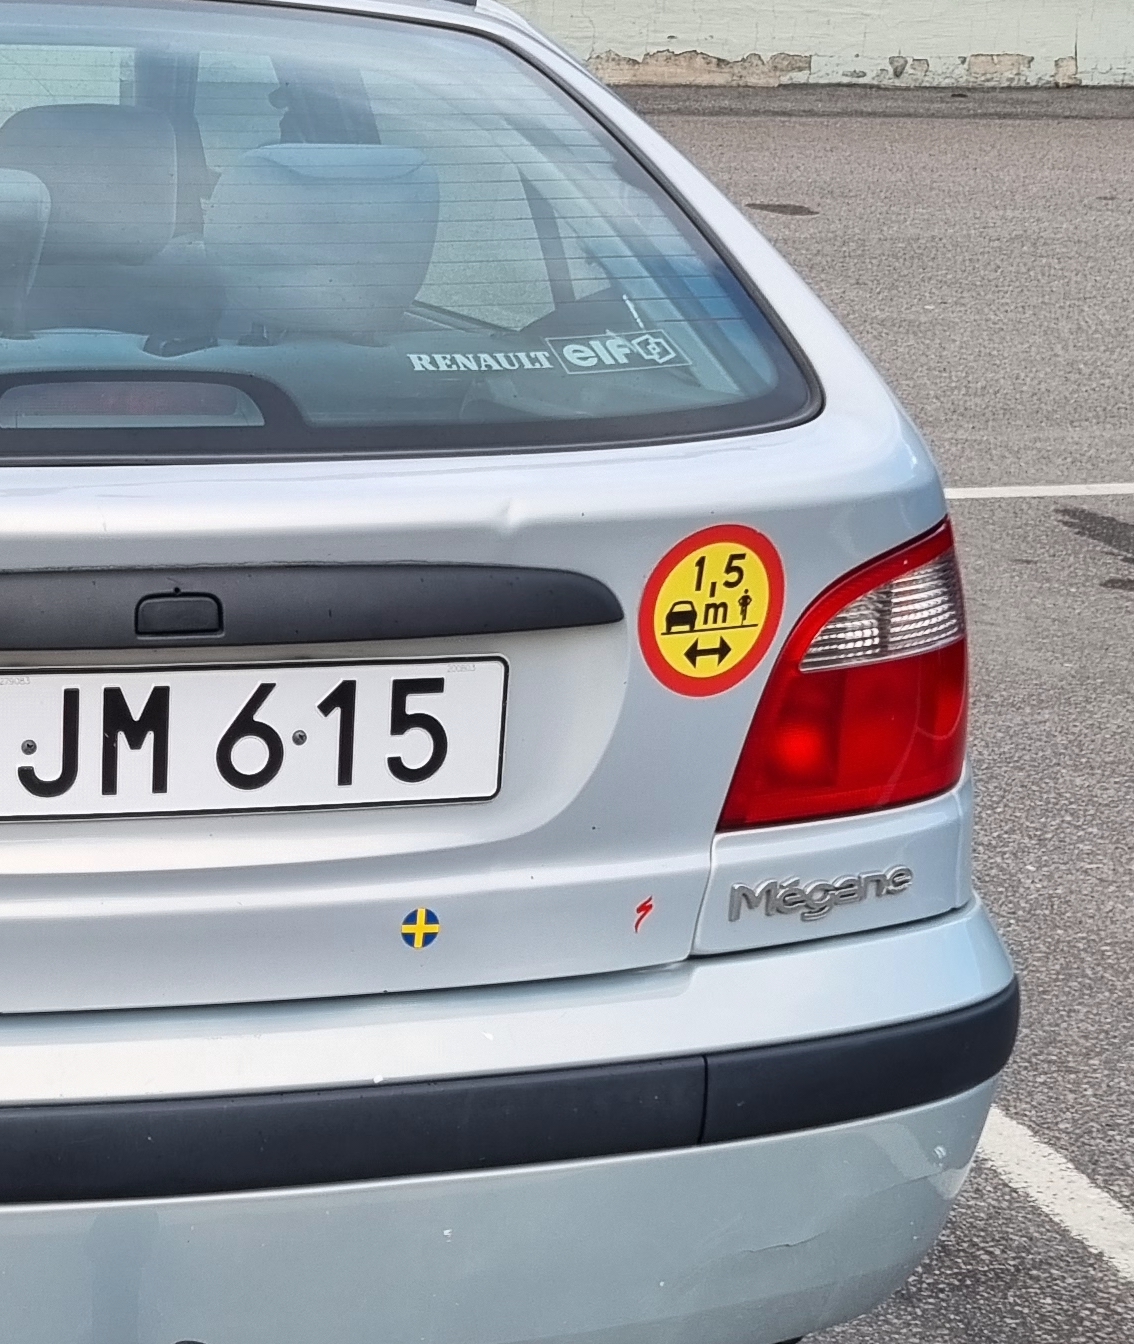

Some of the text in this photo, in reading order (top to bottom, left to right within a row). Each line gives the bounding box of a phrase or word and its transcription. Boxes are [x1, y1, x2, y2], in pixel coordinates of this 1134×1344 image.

[407, 336, 634, 371] RENAULT elf
[694, 553, 747, 598] 1,5
[702, 601, 729, 625] m
[216, 677, 448, 790] 615
[729, 864, 914, 922] Mégane
